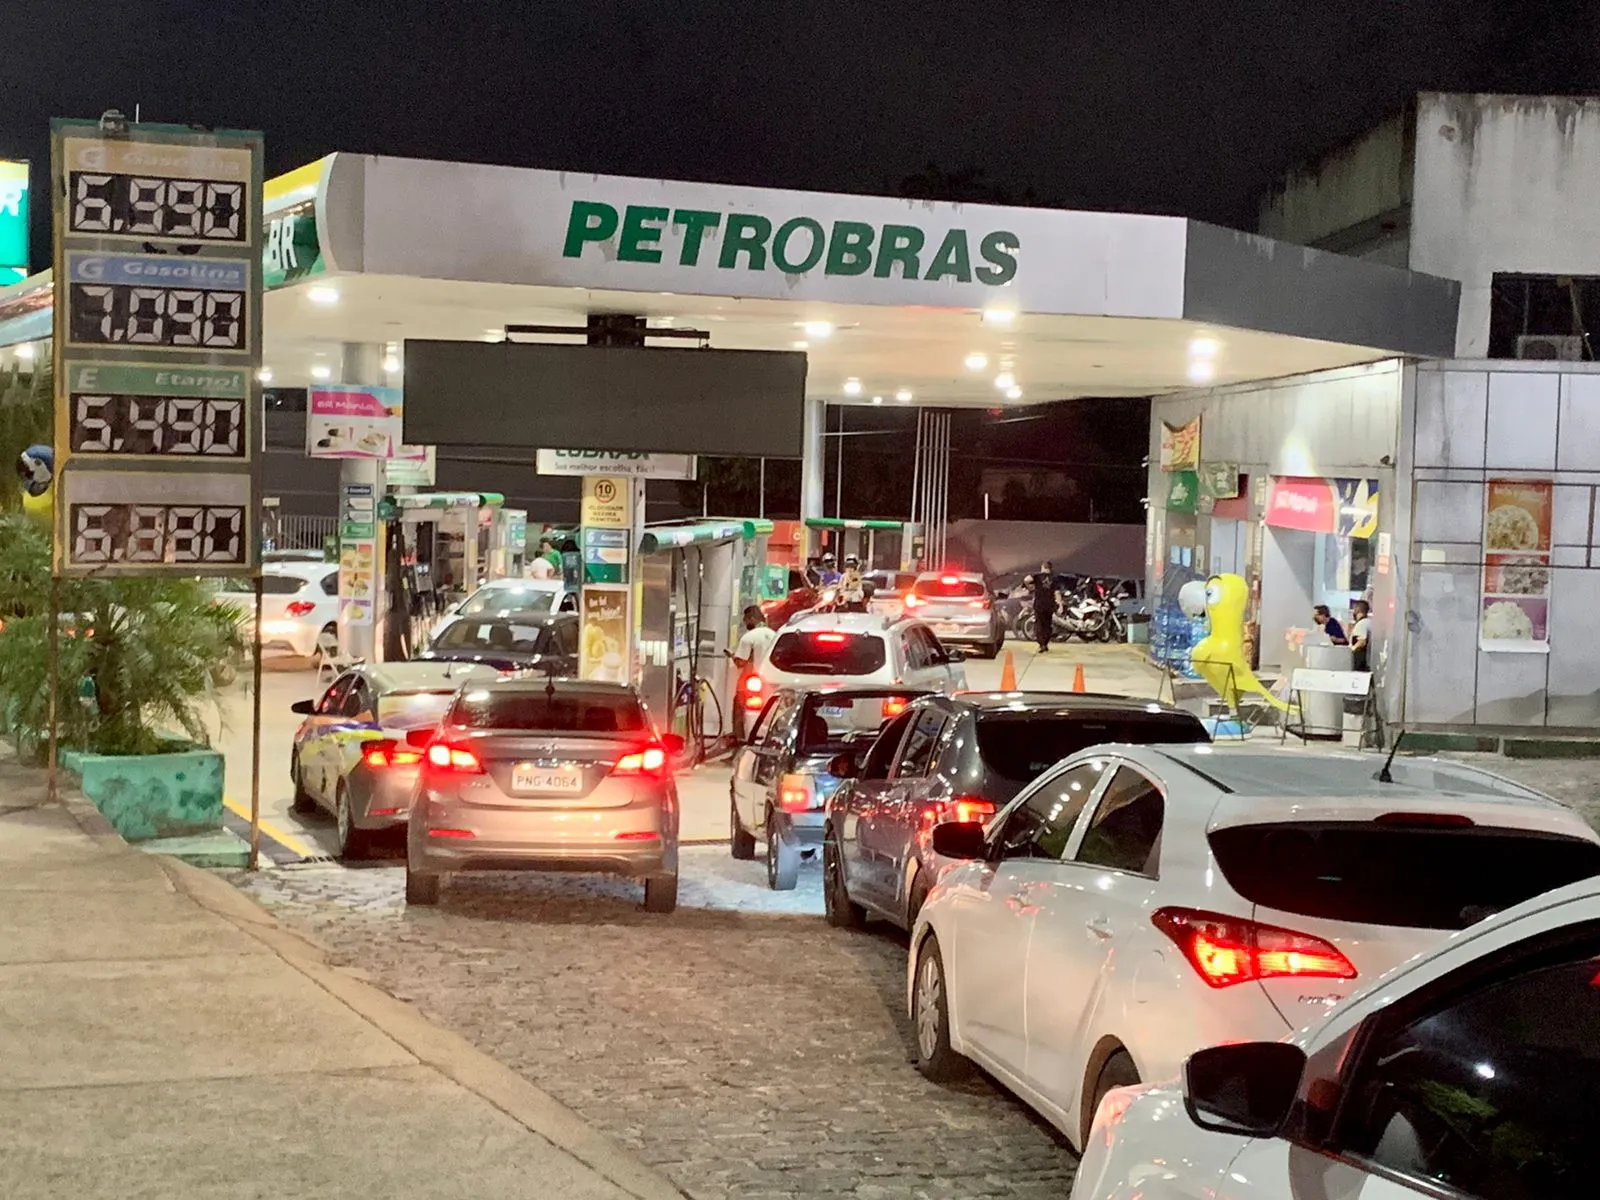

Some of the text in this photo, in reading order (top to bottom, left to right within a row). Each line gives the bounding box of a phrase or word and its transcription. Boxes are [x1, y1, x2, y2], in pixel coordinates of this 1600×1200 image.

[268, 213, 298, 272] BR
[562, 200, 1020, 286] PETROBRAS
[77, 258, 240, 279] G Gasolina
[77, 368, 240, 389] E Etanol
[598, 484, 612, 494] 10
